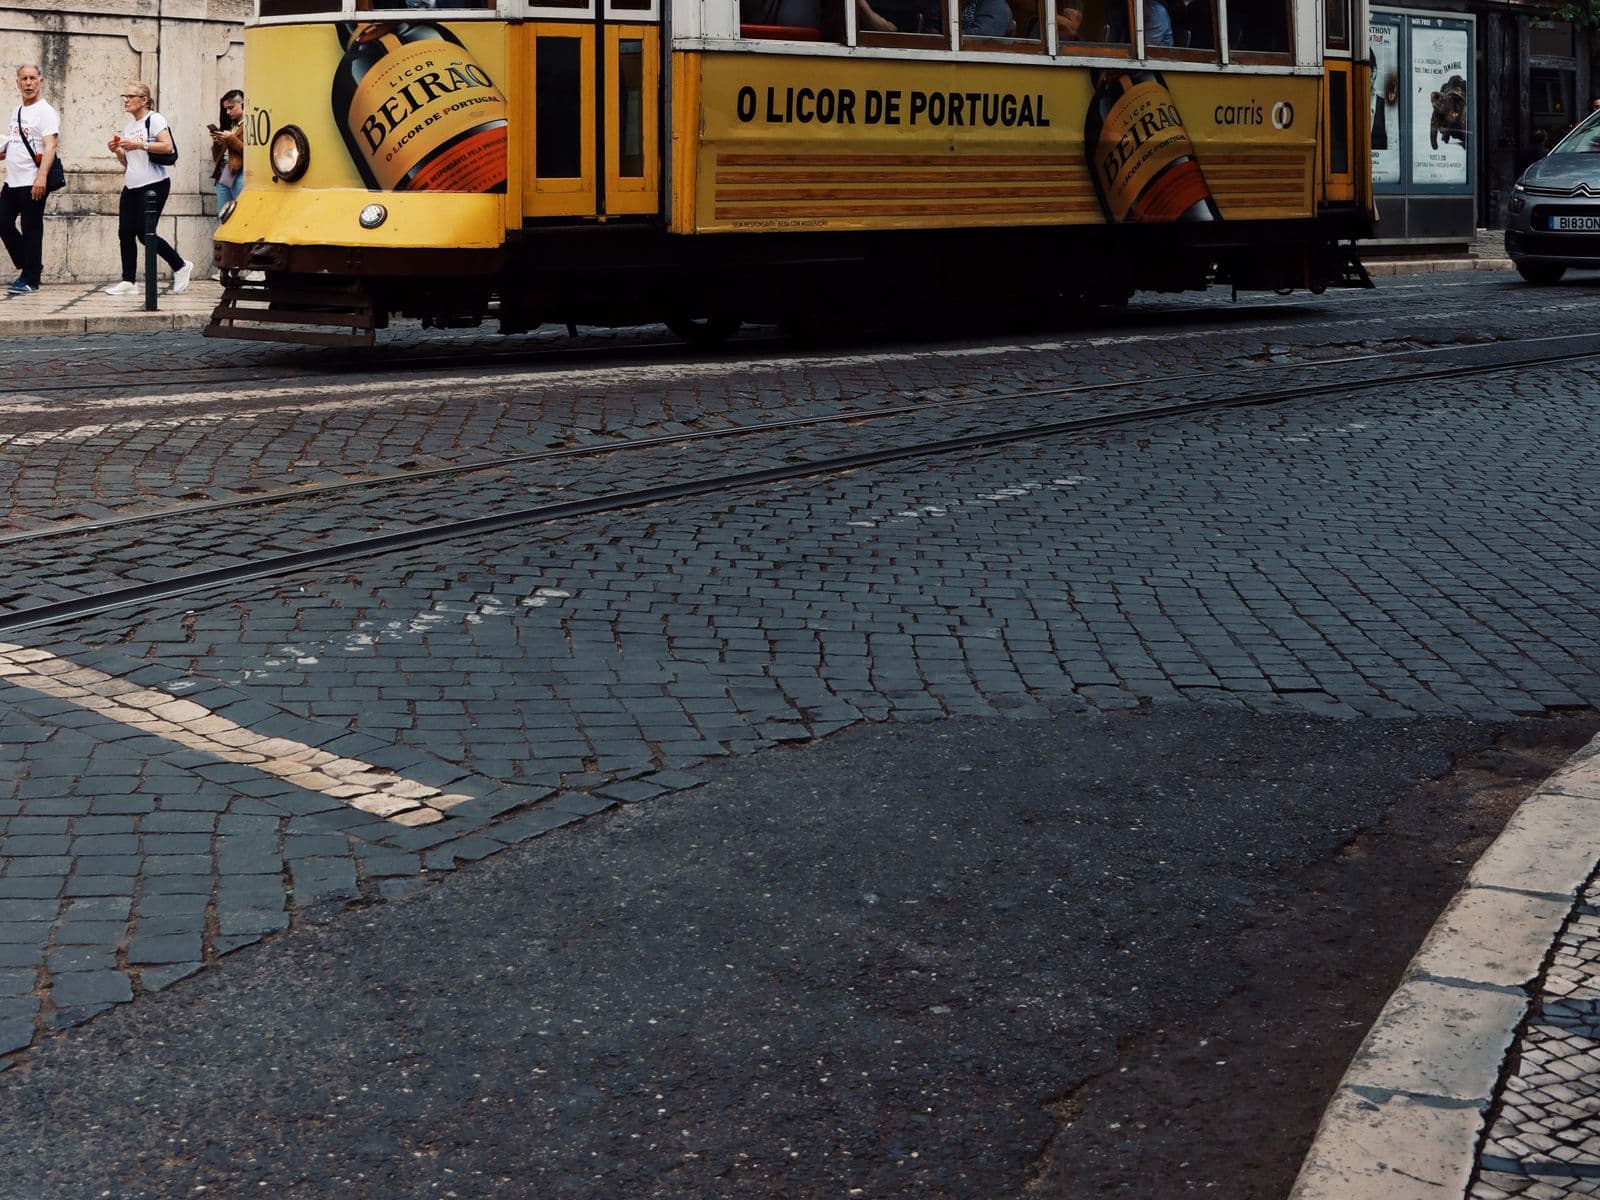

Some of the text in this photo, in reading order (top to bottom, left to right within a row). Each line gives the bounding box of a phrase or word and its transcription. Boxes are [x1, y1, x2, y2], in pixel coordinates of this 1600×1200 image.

[389, 60, 435, 88] LICOR
[359, 61, 493, 157] BEIRÃO
[392, 123, 425, 155] LICOR
[424, 112, 442, 127] DE
[442, 95, 500, 116] PORTUGAL
[736, 86, 1050, 127] O LICOR DE PORTUGAL
[1123, 100, 1152, 126] LICOR
[1214, 98, 1263, 125] carris
[1103, 101, 1183, 189] BEIRÃO
